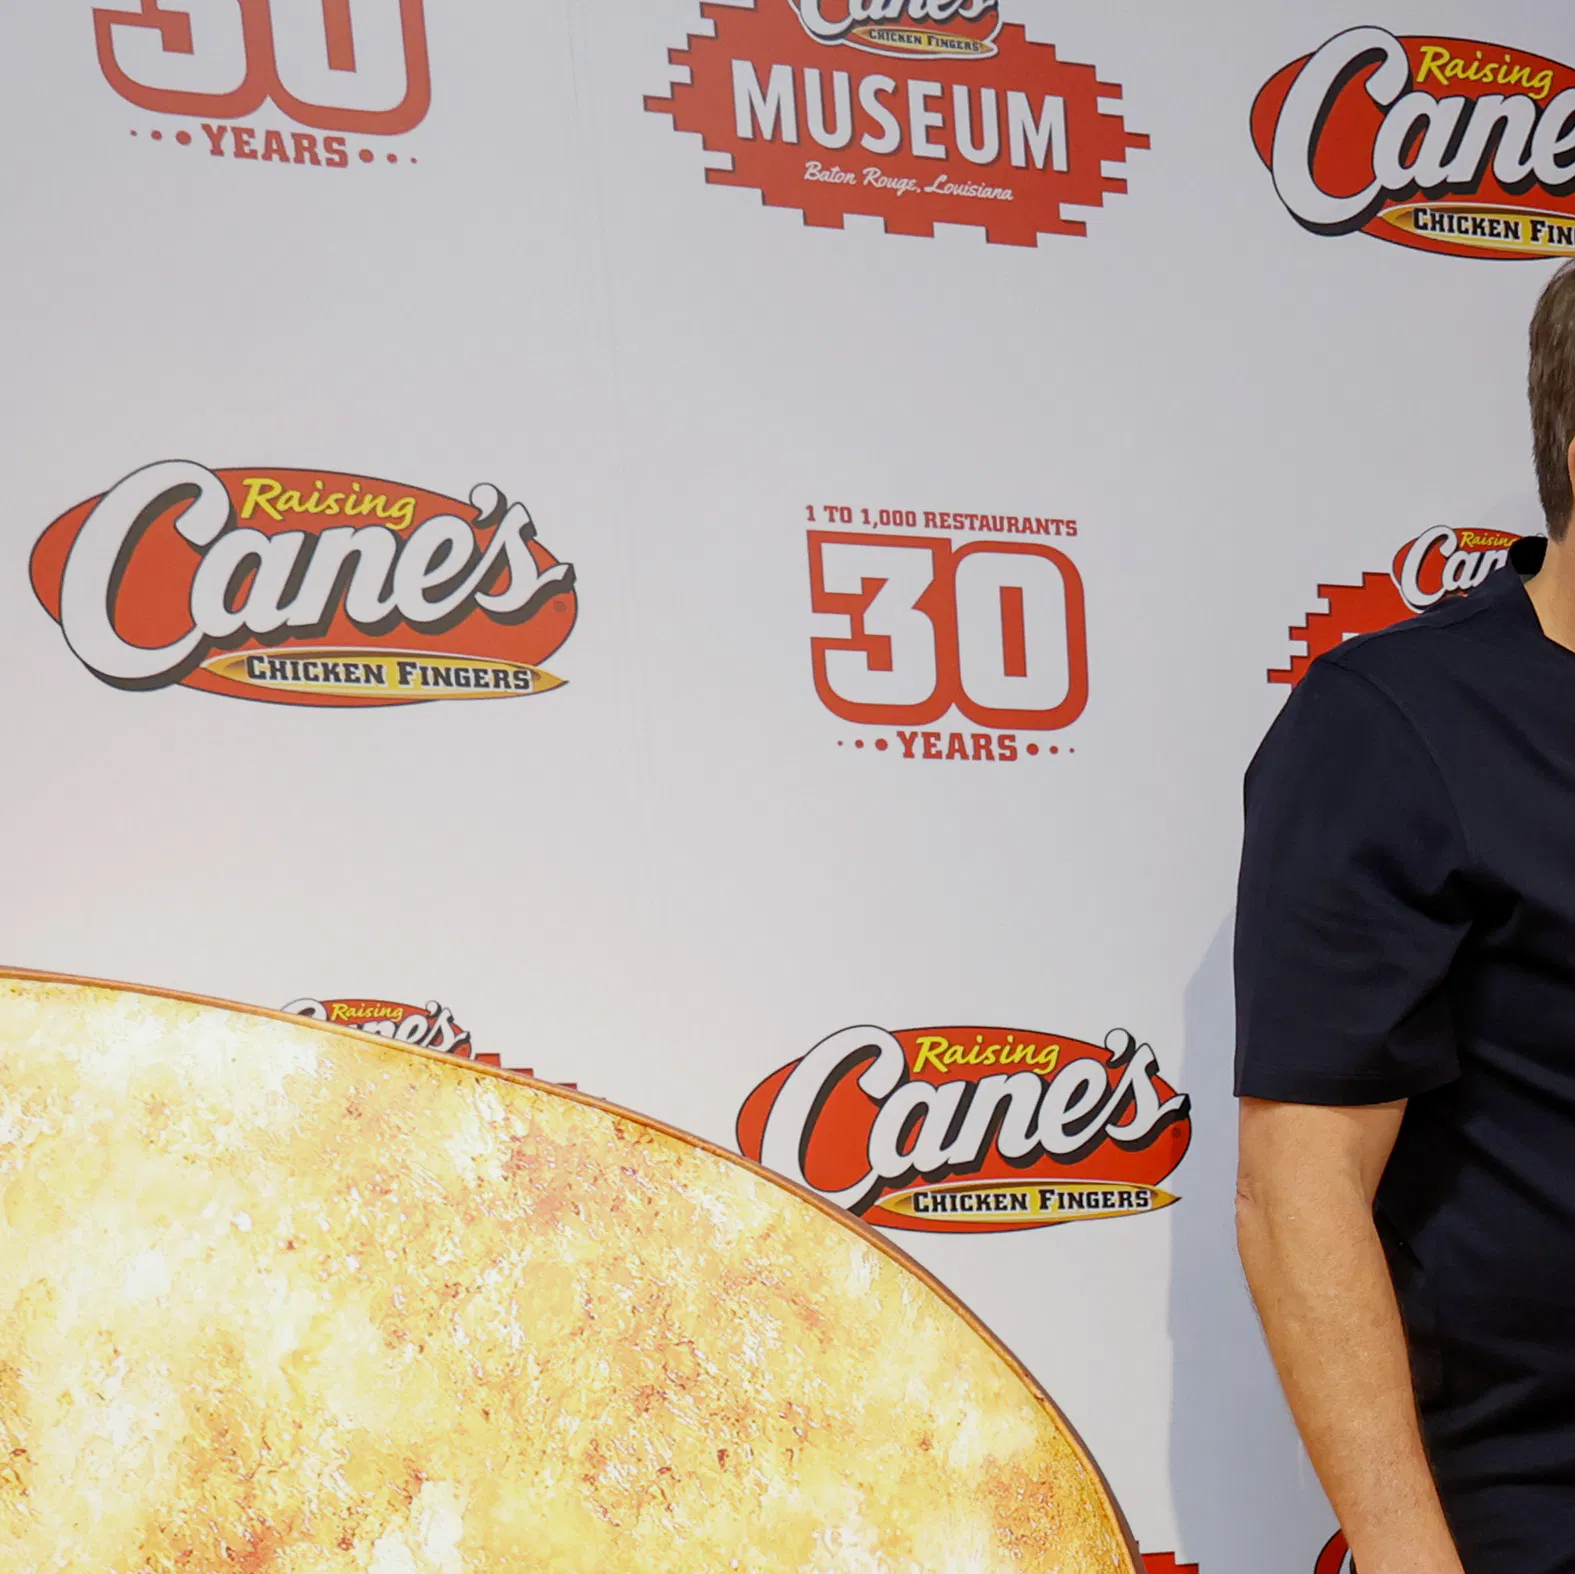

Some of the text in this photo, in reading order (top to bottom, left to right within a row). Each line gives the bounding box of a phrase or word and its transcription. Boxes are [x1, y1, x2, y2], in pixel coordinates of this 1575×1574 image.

[731, 59, 1069, 173] MUSEUM
[202, 124, 350, 170] YEARS
[804, 160, 1014, 201] Baton Rouge, Louisiana
[240, 476, 417, 526] Raising
[805, 505, 1079, 538] 1 TO 1,000 RESTAURANTS
[60, 458, 576, 692] Cane's
[807, 530, 1089, 730] 30
[244, 653, 533, 694] CHICKEN FINGERS
[896, 730, 1019, 762] YEARS
